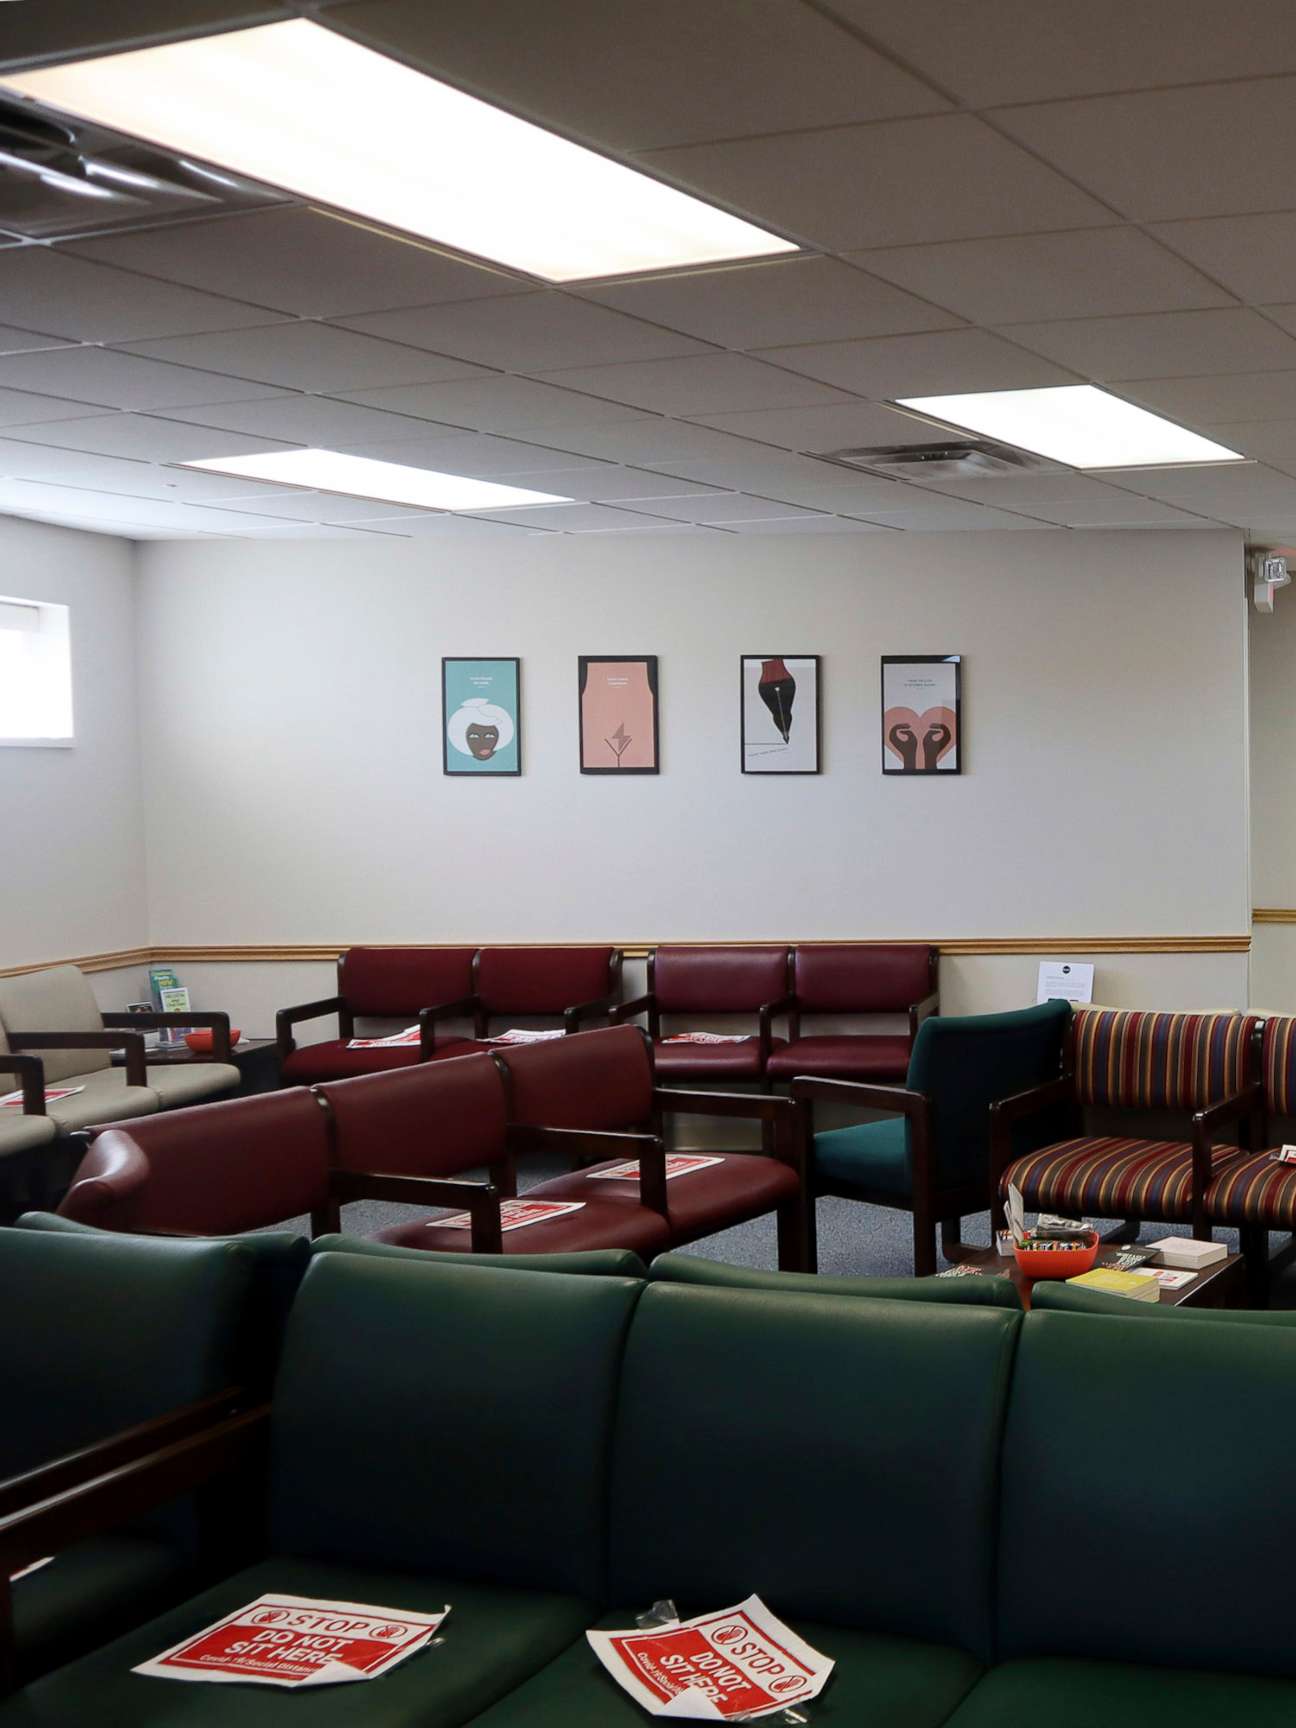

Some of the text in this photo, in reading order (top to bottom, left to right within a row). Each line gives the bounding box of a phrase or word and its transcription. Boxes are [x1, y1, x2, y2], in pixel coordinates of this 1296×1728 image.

[289, 1615, 371, 1634] STOP
[253, 1630, 354, 1651] DO NOT
[224, 1641, 344, 1665] SIT HERE
[659, 1653, 692, 1675] SIT
[731, 1641, 785, 1676] STOP
[689, 1650, 753, 1692] DO NOT
